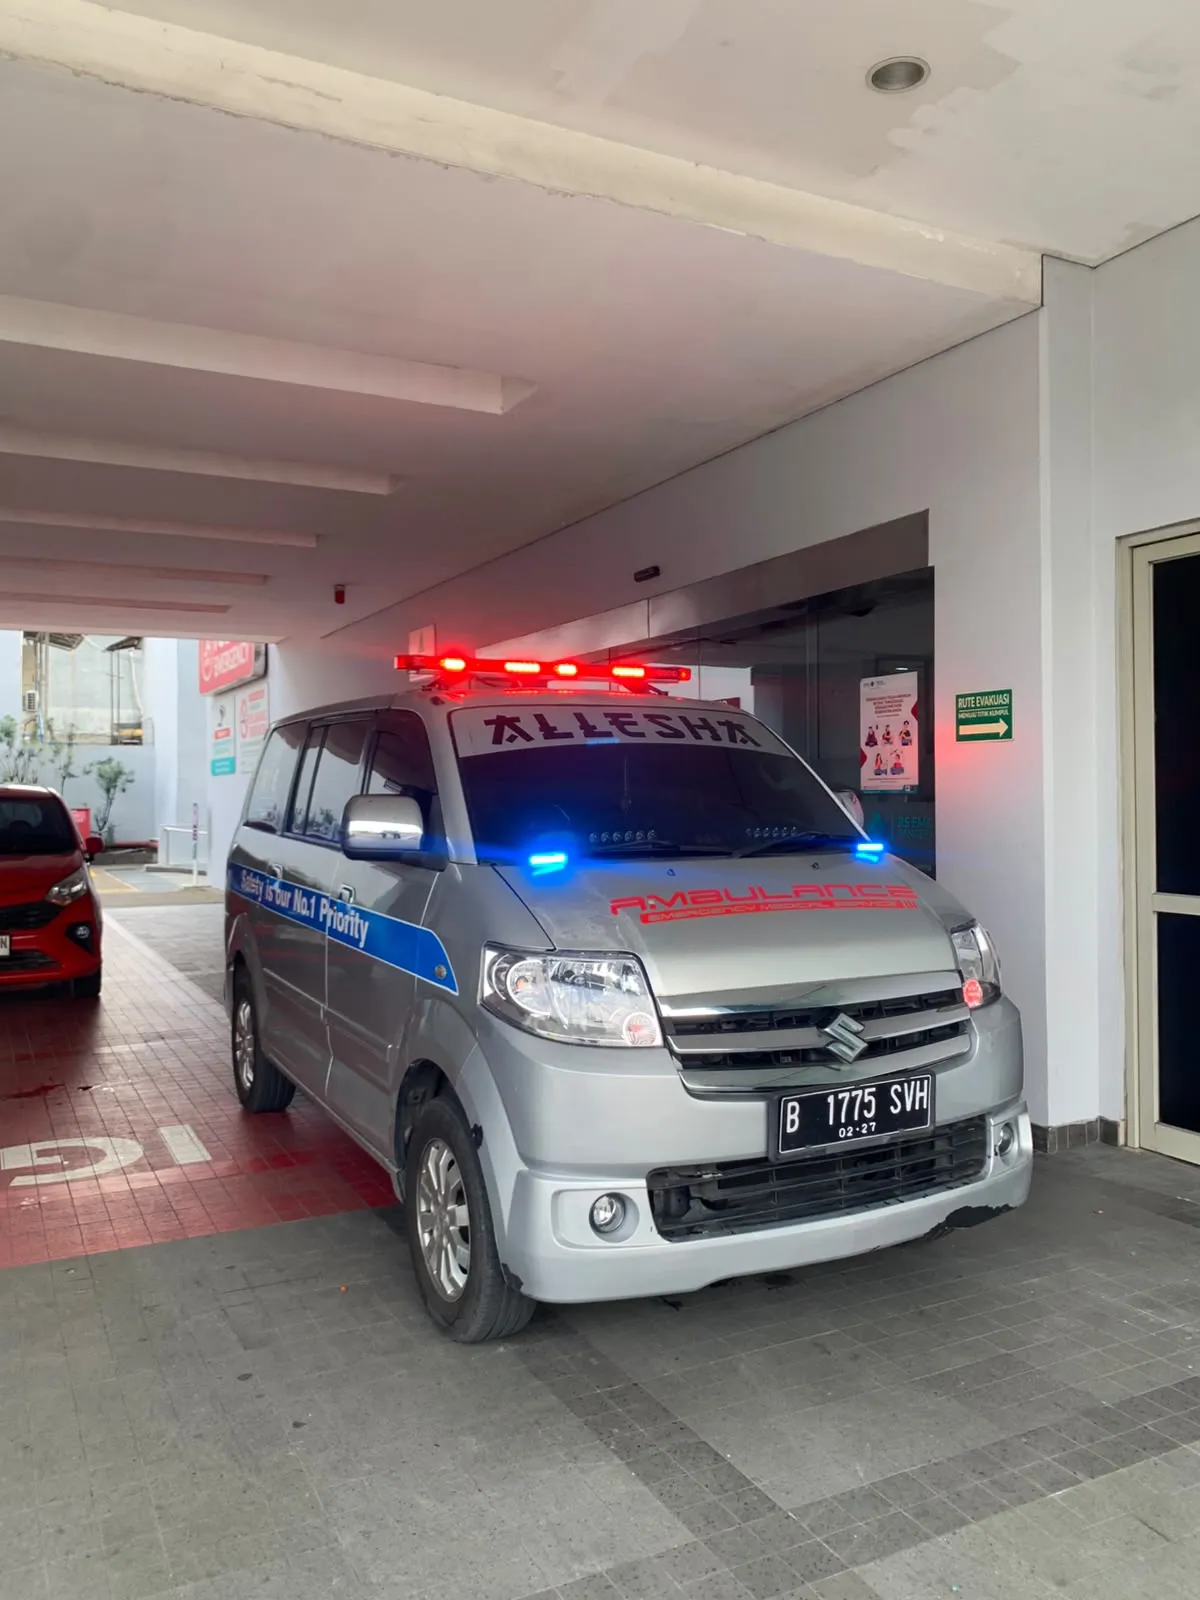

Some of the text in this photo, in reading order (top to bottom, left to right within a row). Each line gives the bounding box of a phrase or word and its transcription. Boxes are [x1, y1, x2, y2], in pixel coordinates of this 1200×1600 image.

[958, 693, 1010, 709] RUTE EVAKUASI
[484, 712, 761, 747] ALLESHA
[240, 869, 370, 948] Safety is our No.1 Priority
[610, 883, 918, 915] AMBULANCE
[786, 1079, 929, 1134] B 1775 SVH
